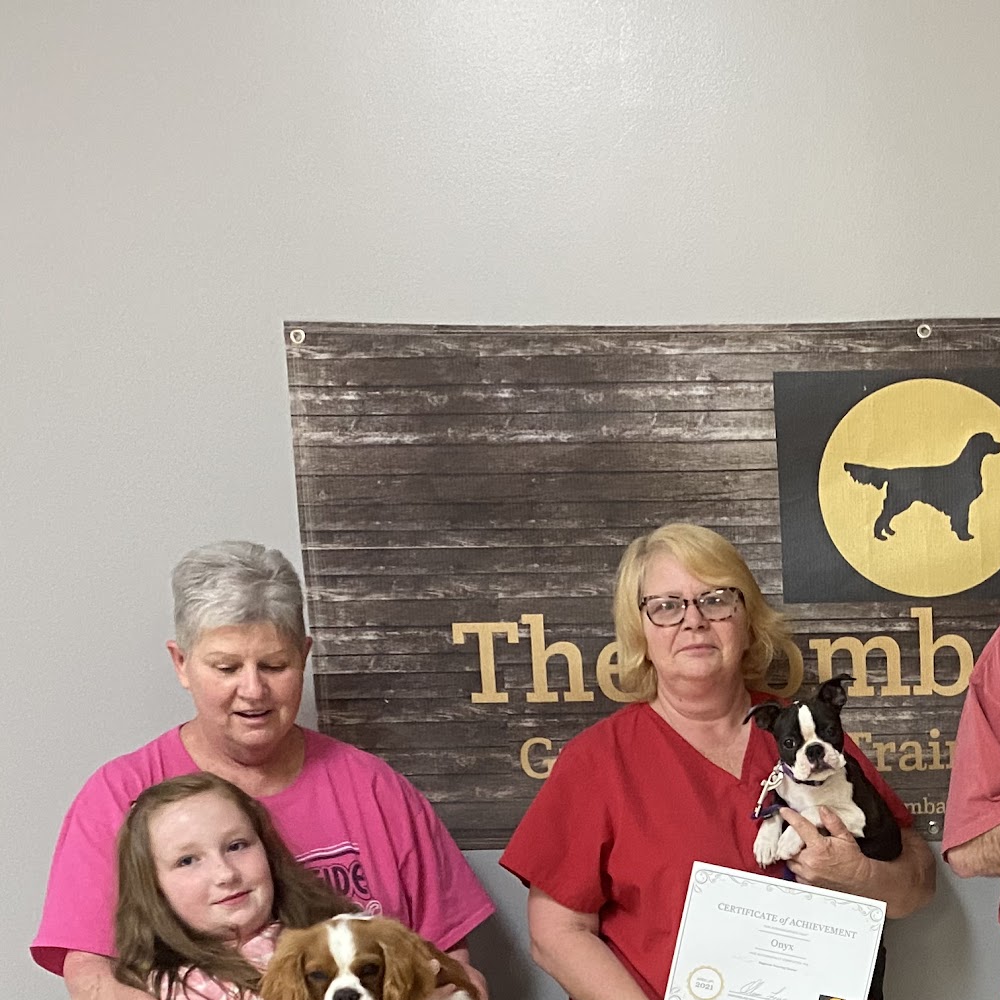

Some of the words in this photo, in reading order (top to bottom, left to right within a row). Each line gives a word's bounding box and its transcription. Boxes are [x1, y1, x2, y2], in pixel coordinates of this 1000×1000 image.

[717, 902, 778, 922] CERTIFICATE
[779, 916, 789, 926] of
[789, 918, 857, 939] ACHIEVEMENT
[770, 938, 794, 952] Onyx
[695, 981, 714, 991] 2021
